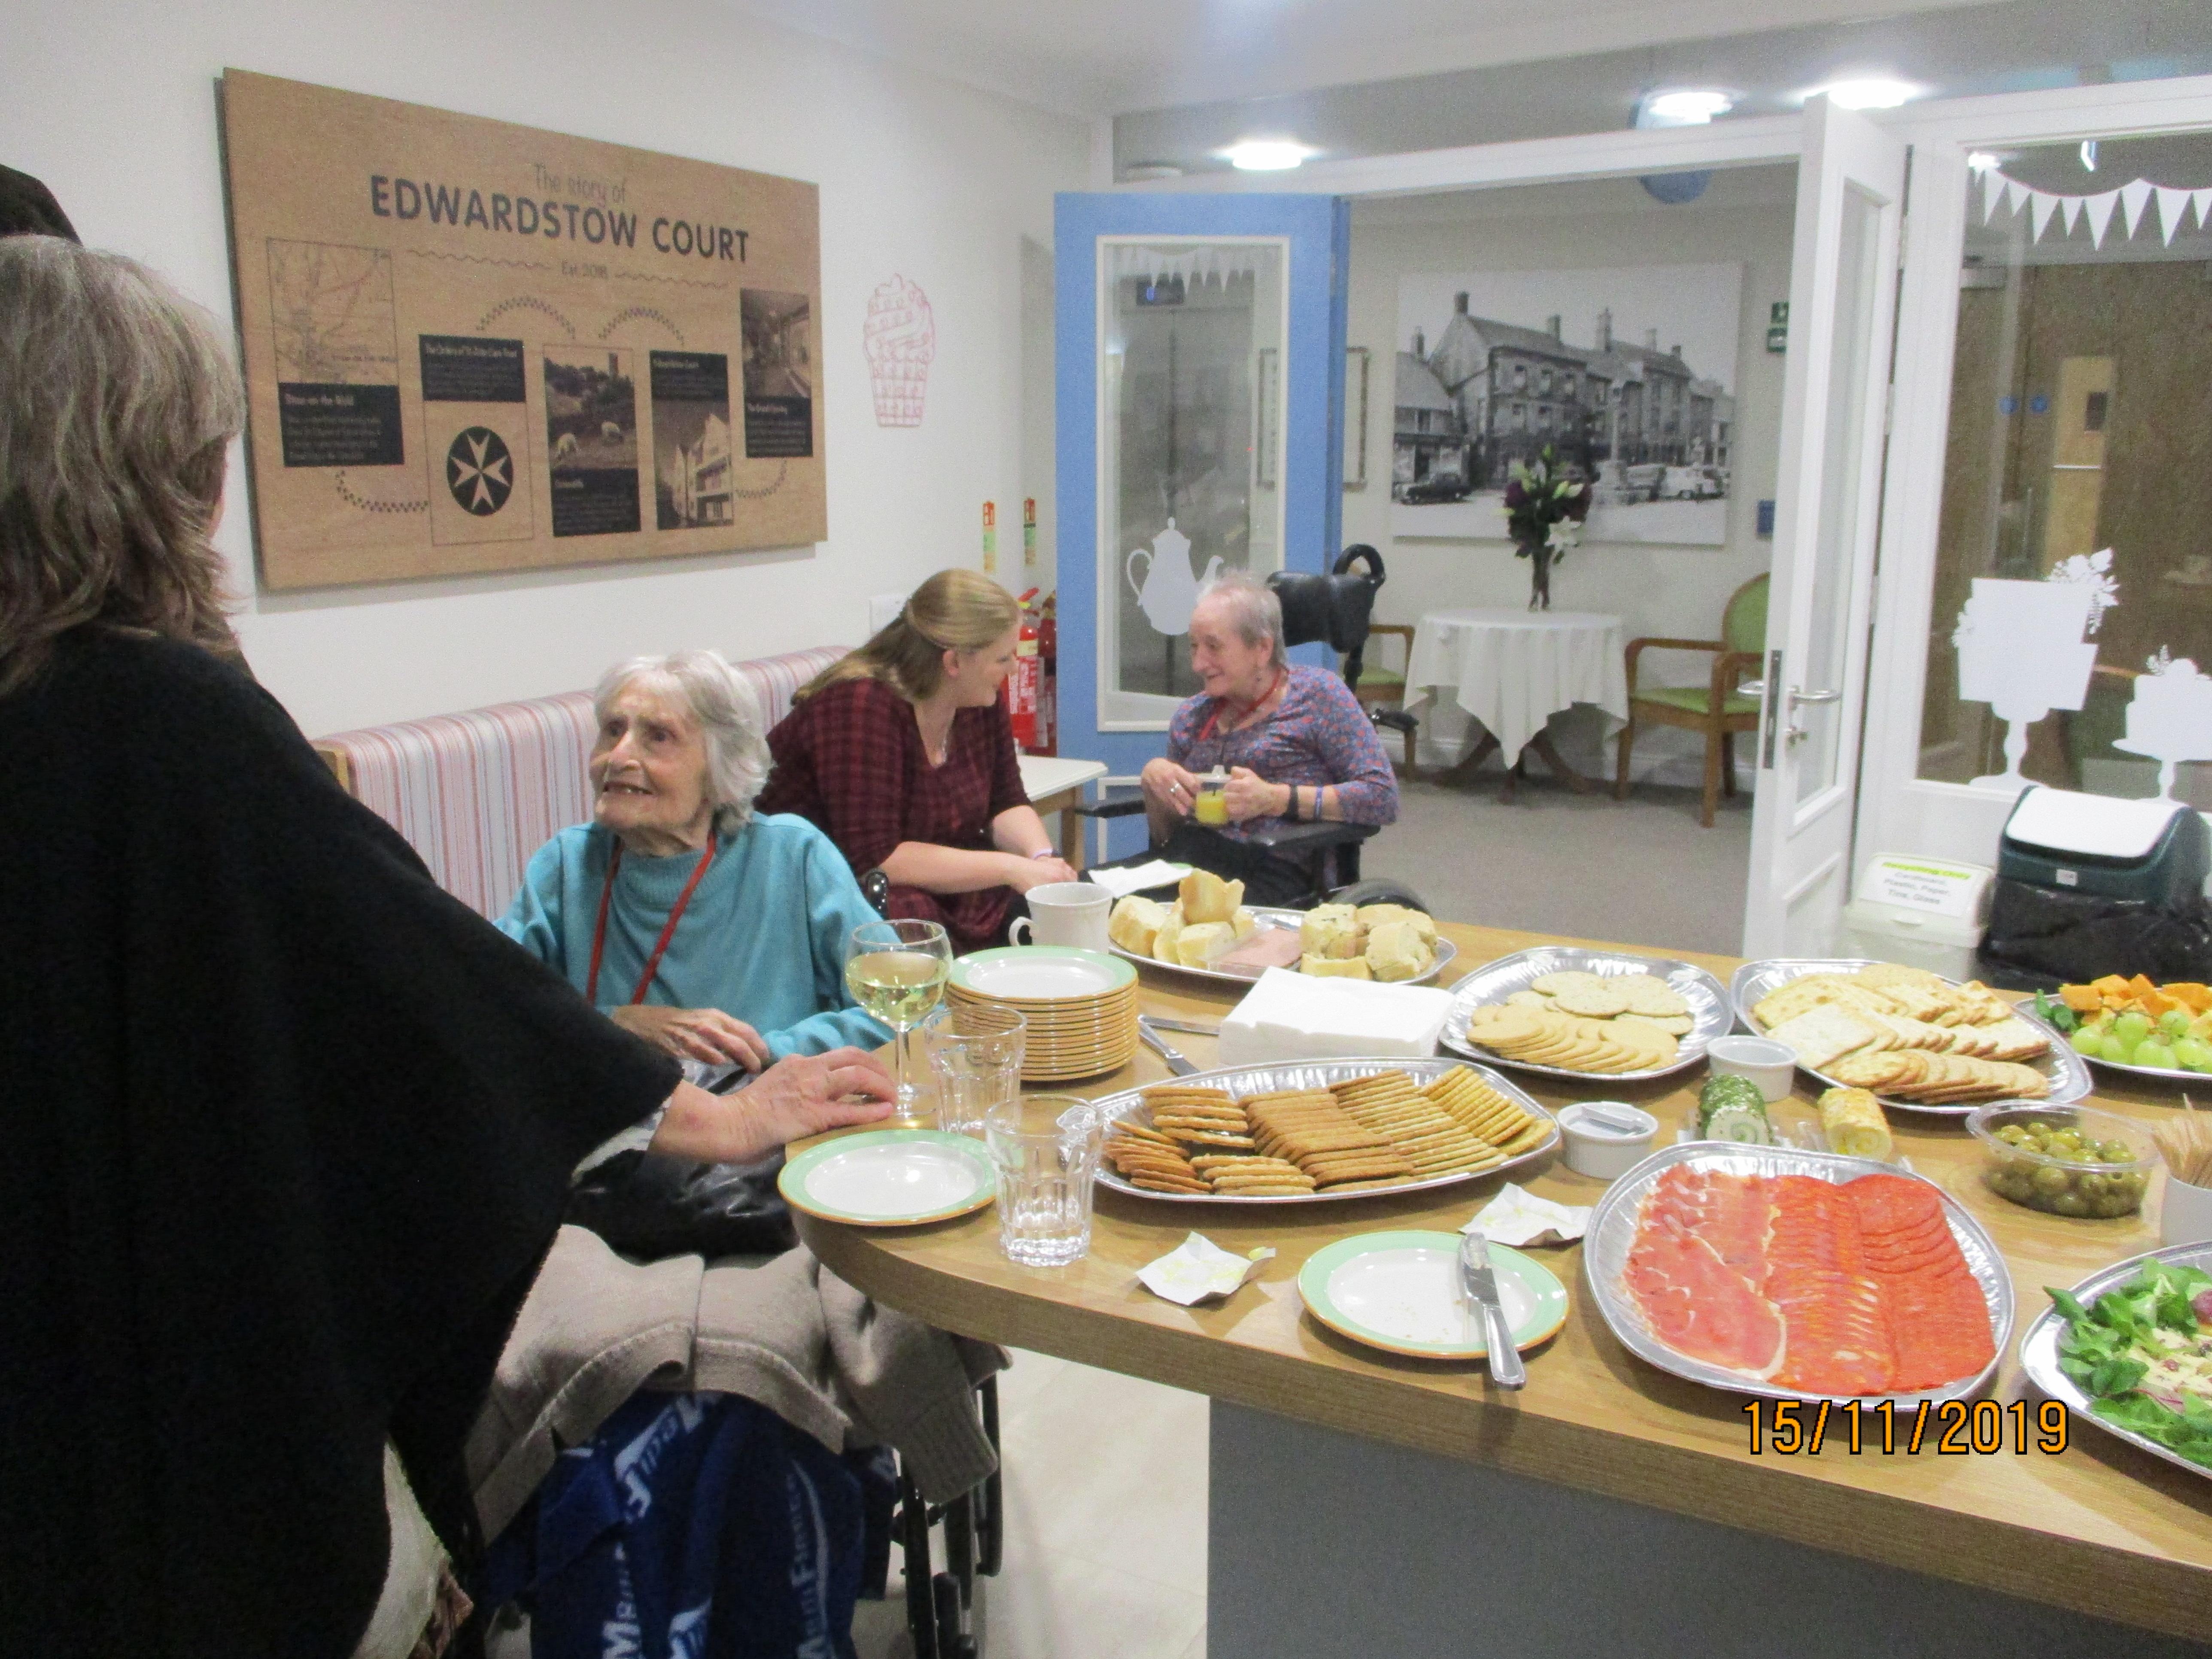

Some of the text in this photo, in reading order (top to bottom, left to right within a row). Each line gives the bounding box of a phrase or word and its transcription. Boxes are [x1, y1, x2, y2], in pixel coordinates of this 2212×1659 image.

[371, 174, 749, 263] EDWARDSTOW COURT
[536, 163, 626, 208] The story of
